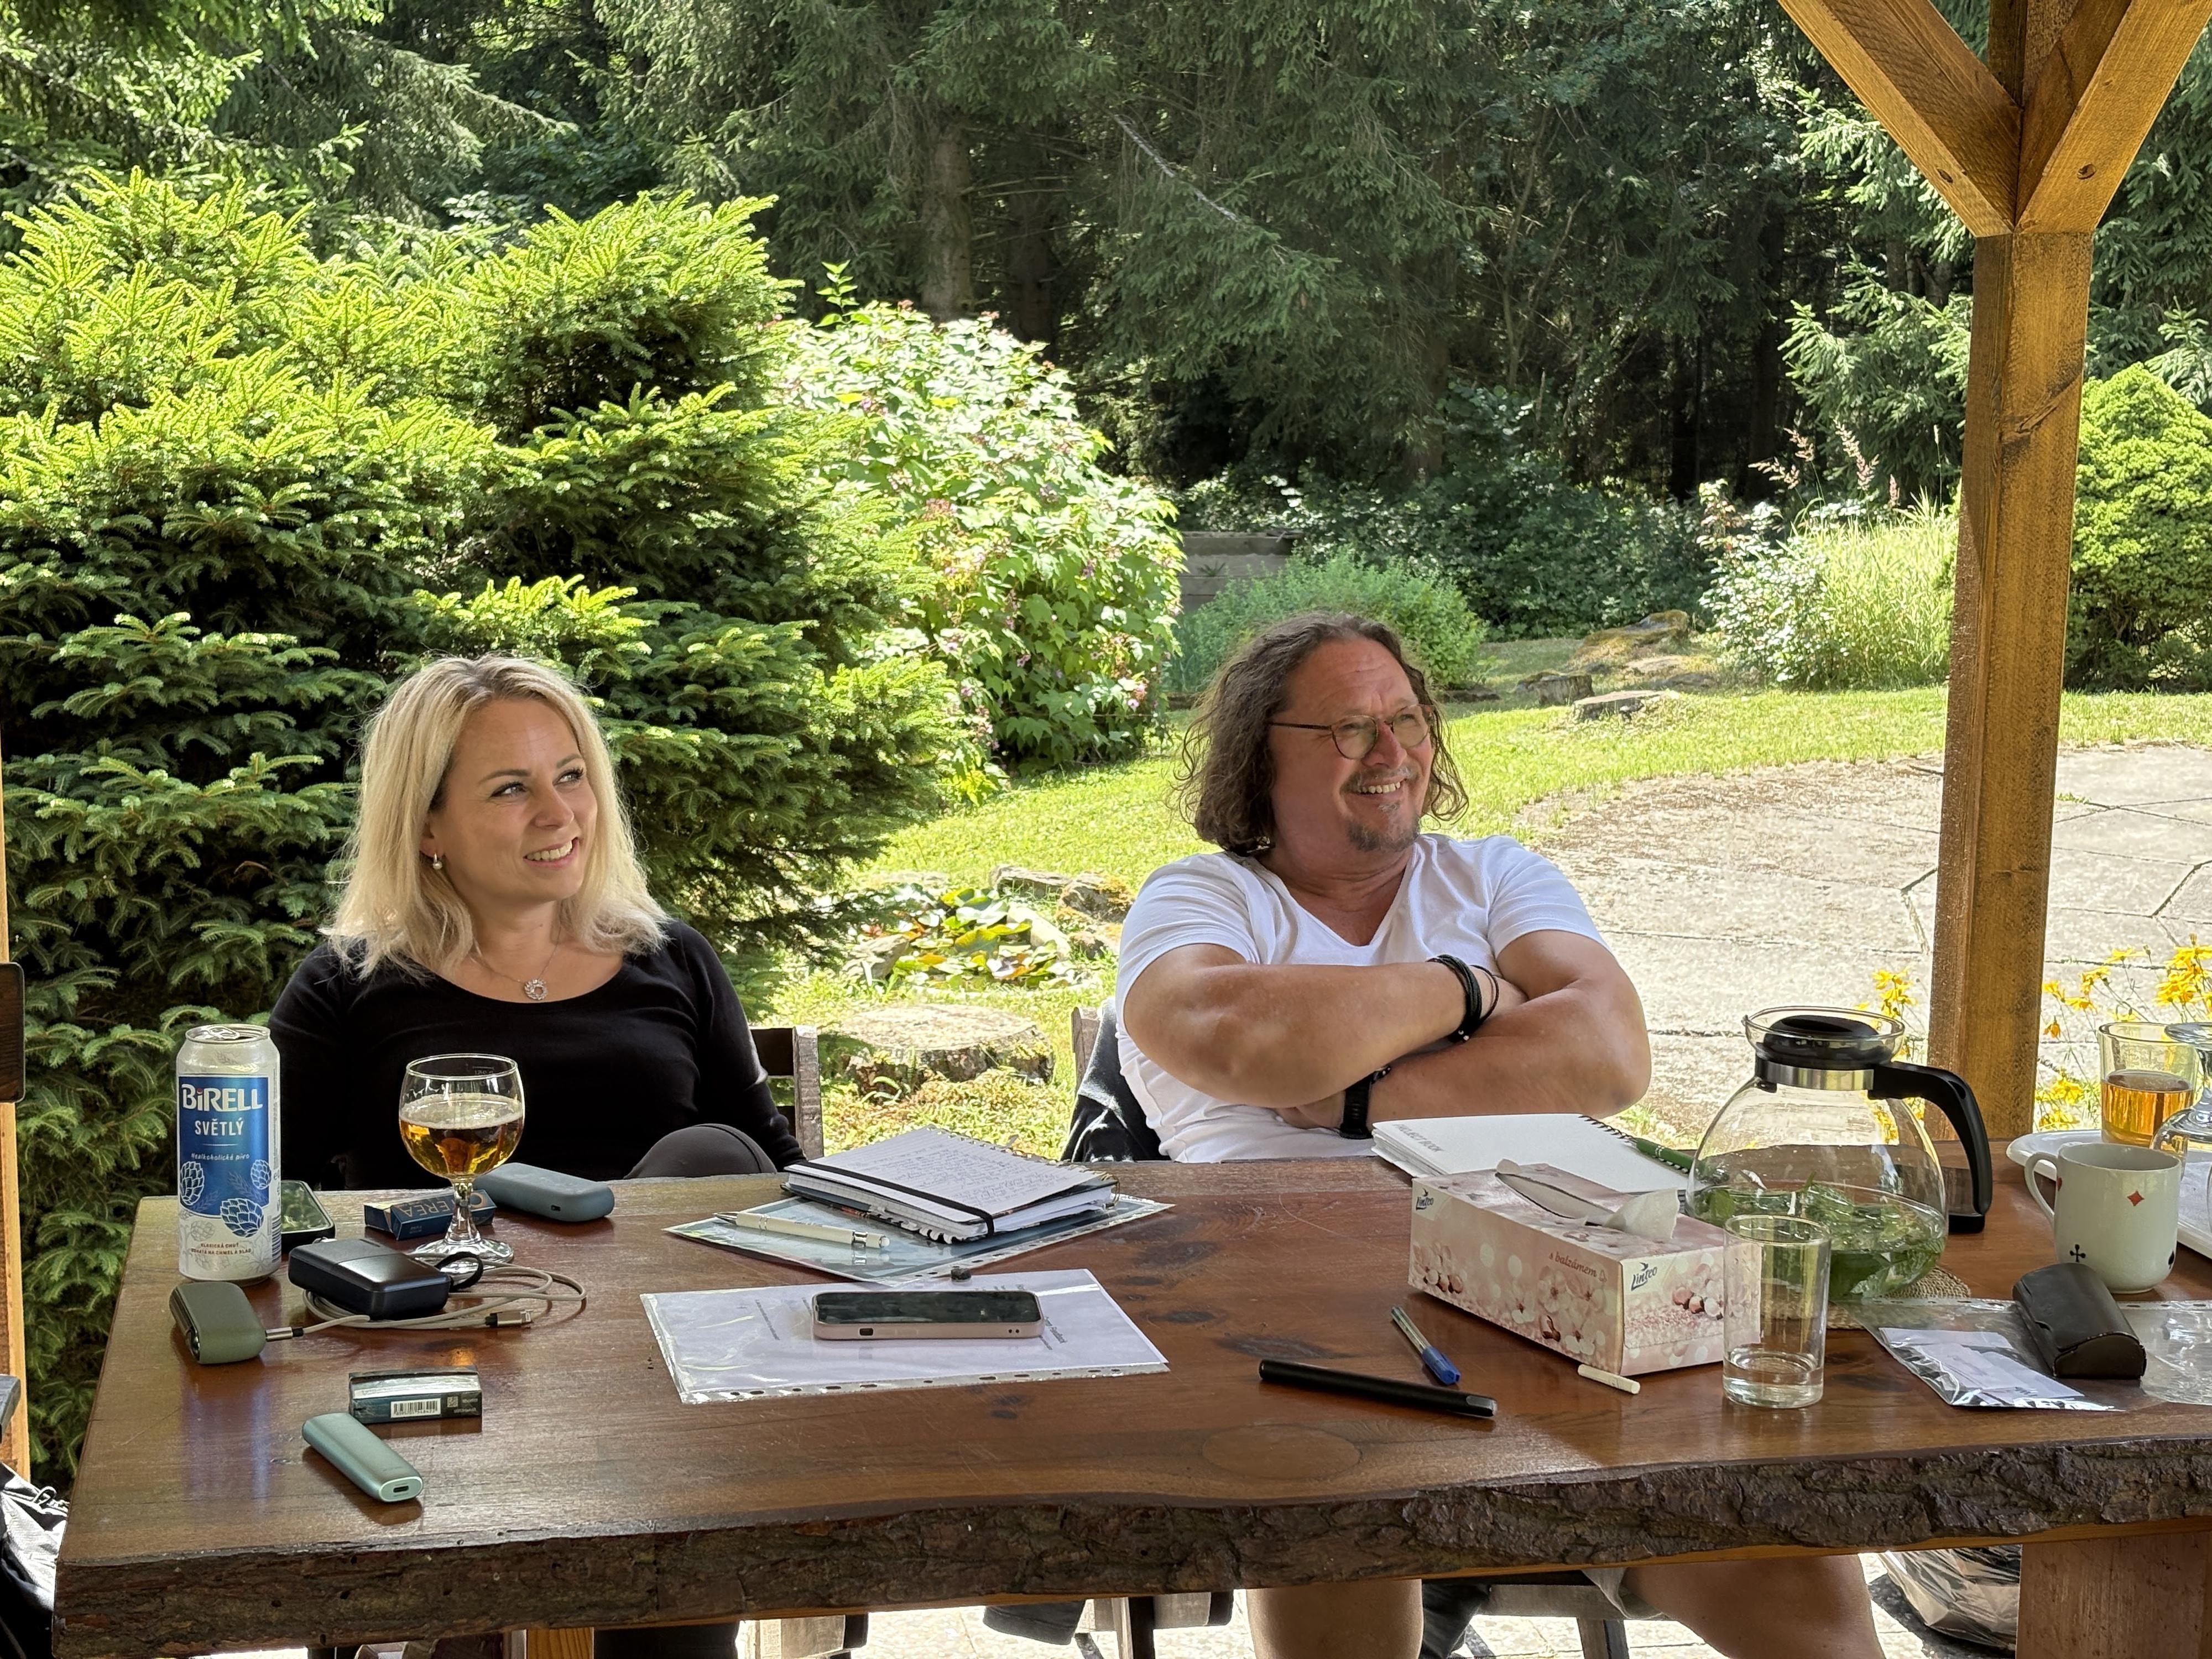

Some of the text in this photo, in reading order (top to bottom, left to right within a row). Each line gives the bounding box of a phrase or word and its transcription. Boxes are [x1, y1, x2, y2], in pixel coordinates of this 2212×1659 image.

[195, 1117, 244, 1136] SVĚTLÝ
[399, 1199, 457, 1217] EREA
[1555, 1251, 1598, 1277] balzámem
[1631, 1266, 1658, 1291] Linteo
